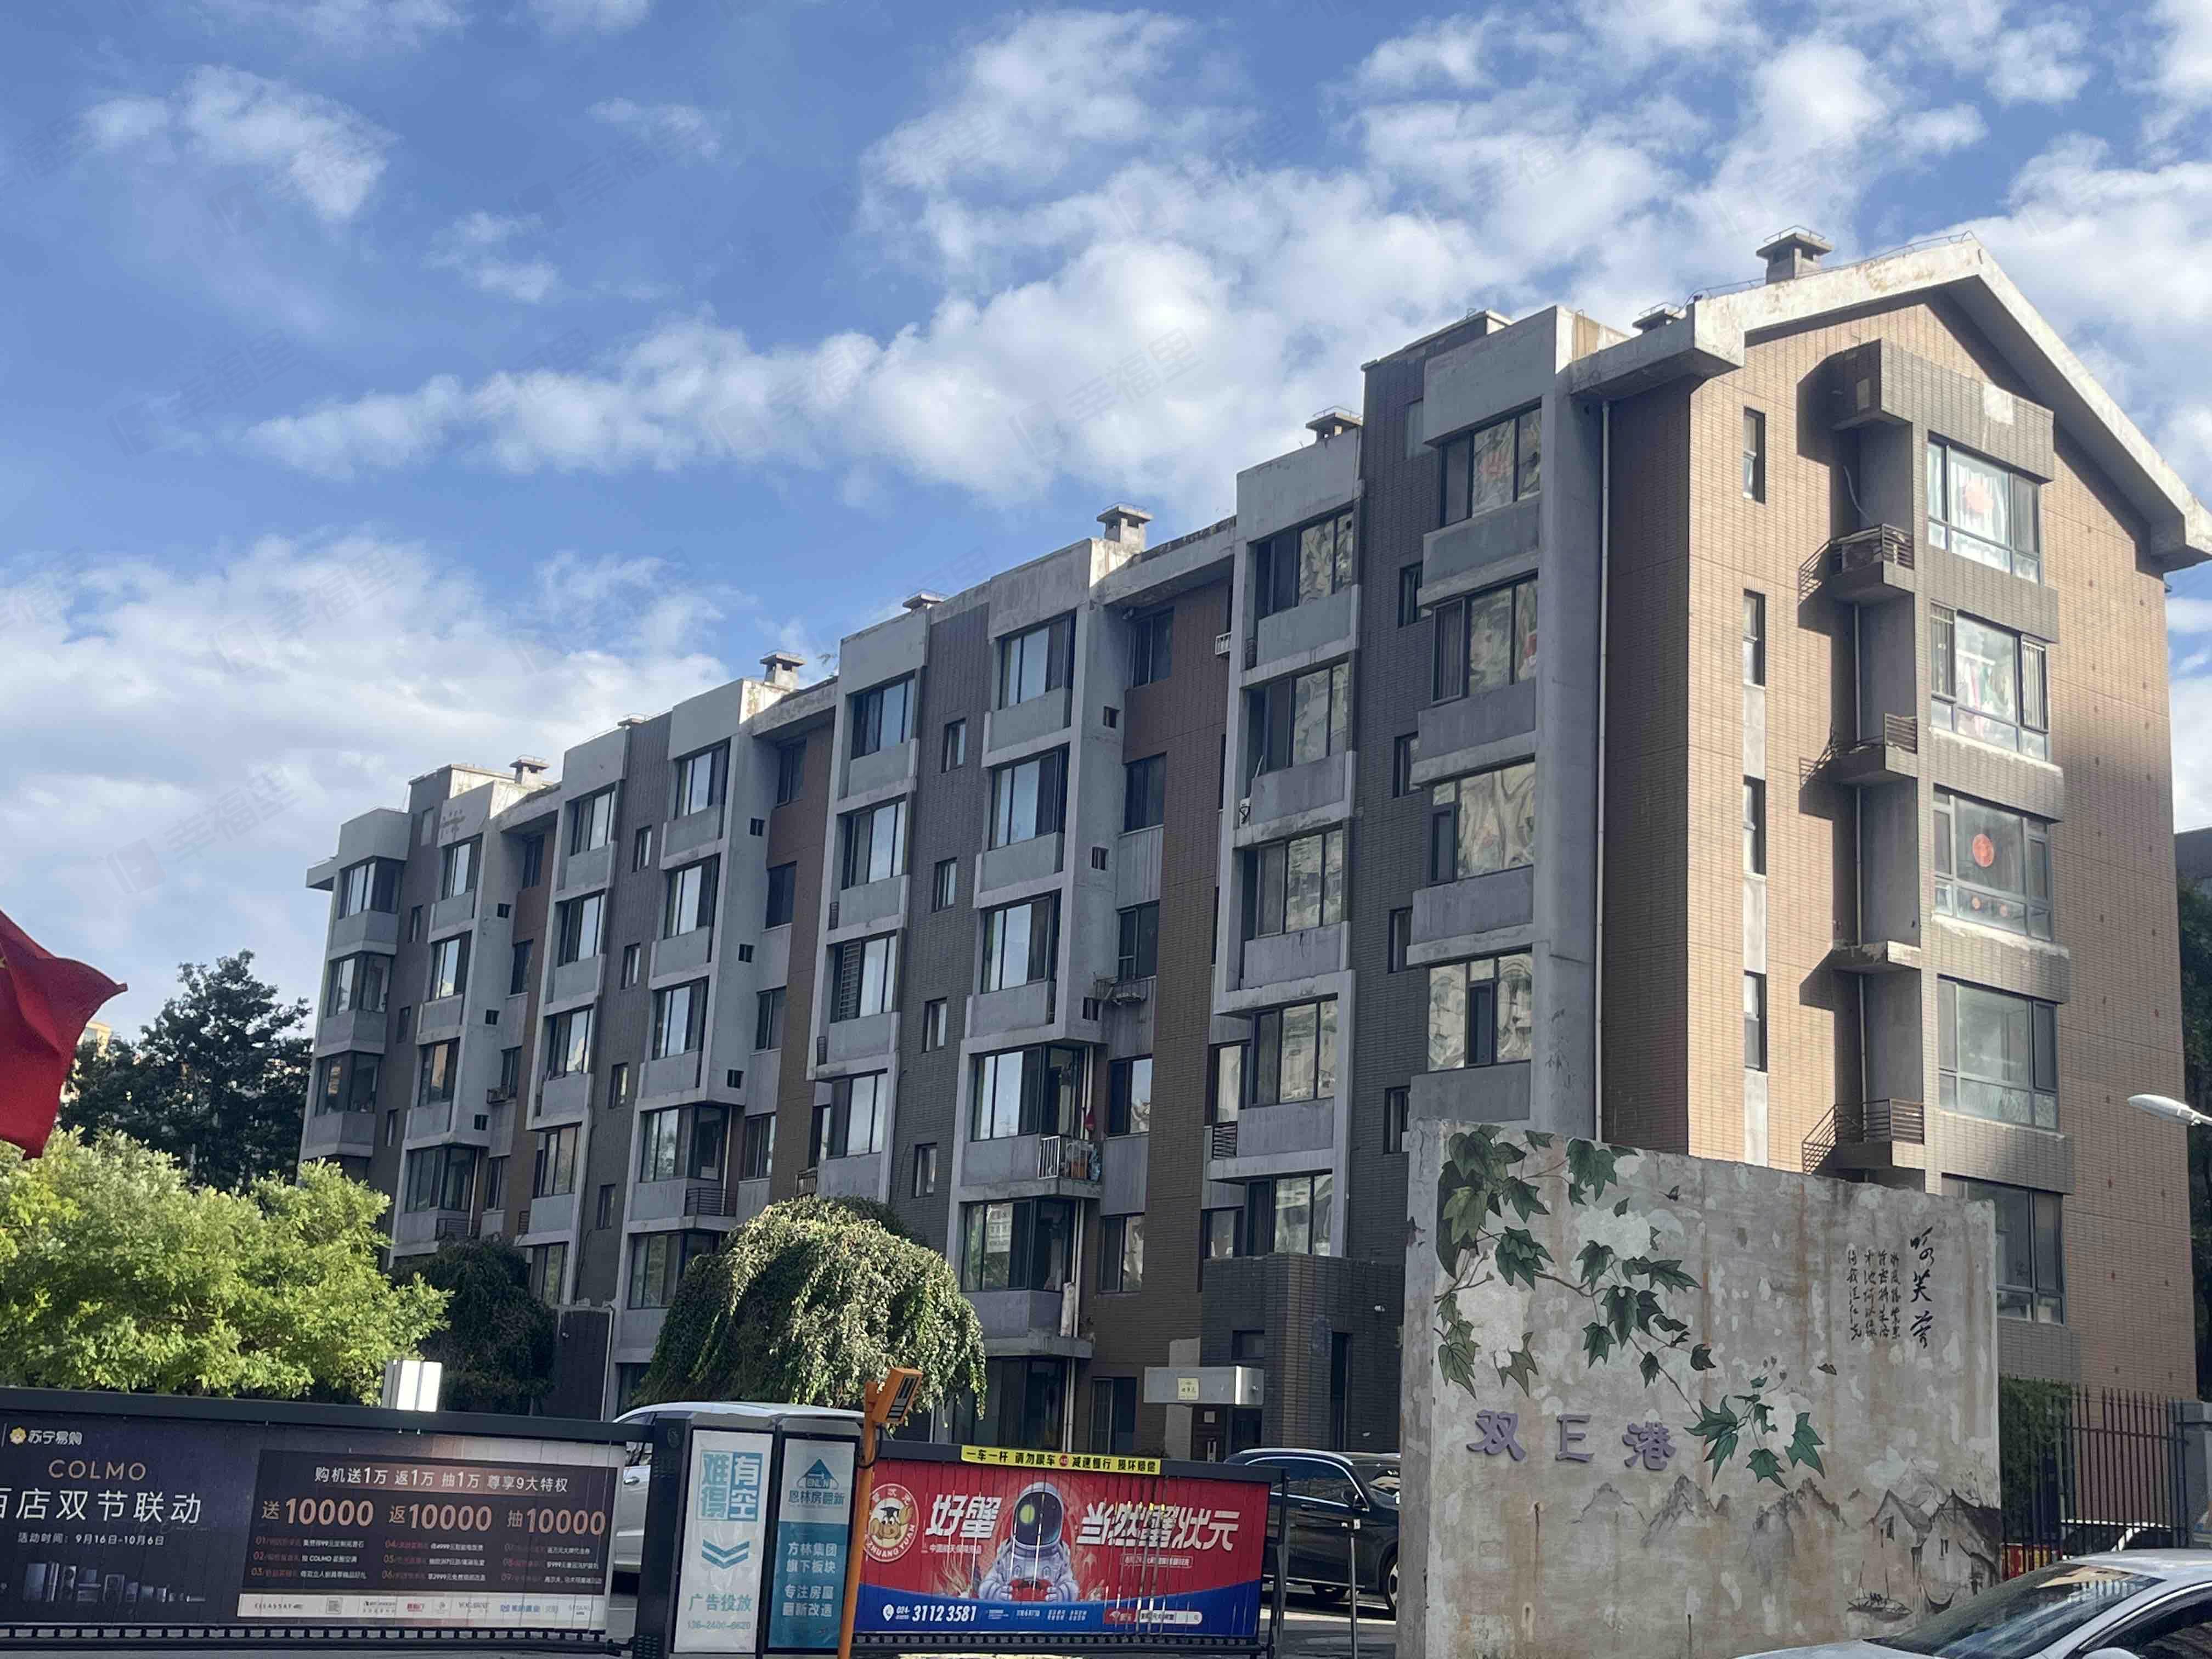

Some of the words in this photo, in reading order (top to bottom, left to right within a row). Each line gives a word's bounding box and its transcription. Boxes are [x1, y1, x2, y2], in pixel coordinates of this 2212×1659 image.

[28, 1430, 82, 1446] 苏宁易购
[967, 1449, 1008, 1463] 一车一杆
[1015, 1452, 1056, 1466] 请勿跟车
[1073, 1456, 1111, 1470] 减速慢行
[48, 1460, 146, 1481] COLMO
[314, 1466, 388, 1485] 购机送1万
[394, 1469, 435, 1487] 返1万
[441, 1471, 481, 1488] 抽1万
[487, 1475, 568, 1493] 尊享9大特权
[730, 1455, 760, 1518] 有空
[787, 1541, 837, 1557] 方林集团
[786, 1559, 836, 1575] 旗下板块
[785, 1584, 834, 1600] 专注房屋
[687, 1593, 753, 1612] 广告投放
[782, 1602, 833, 1618] 翻新改造
